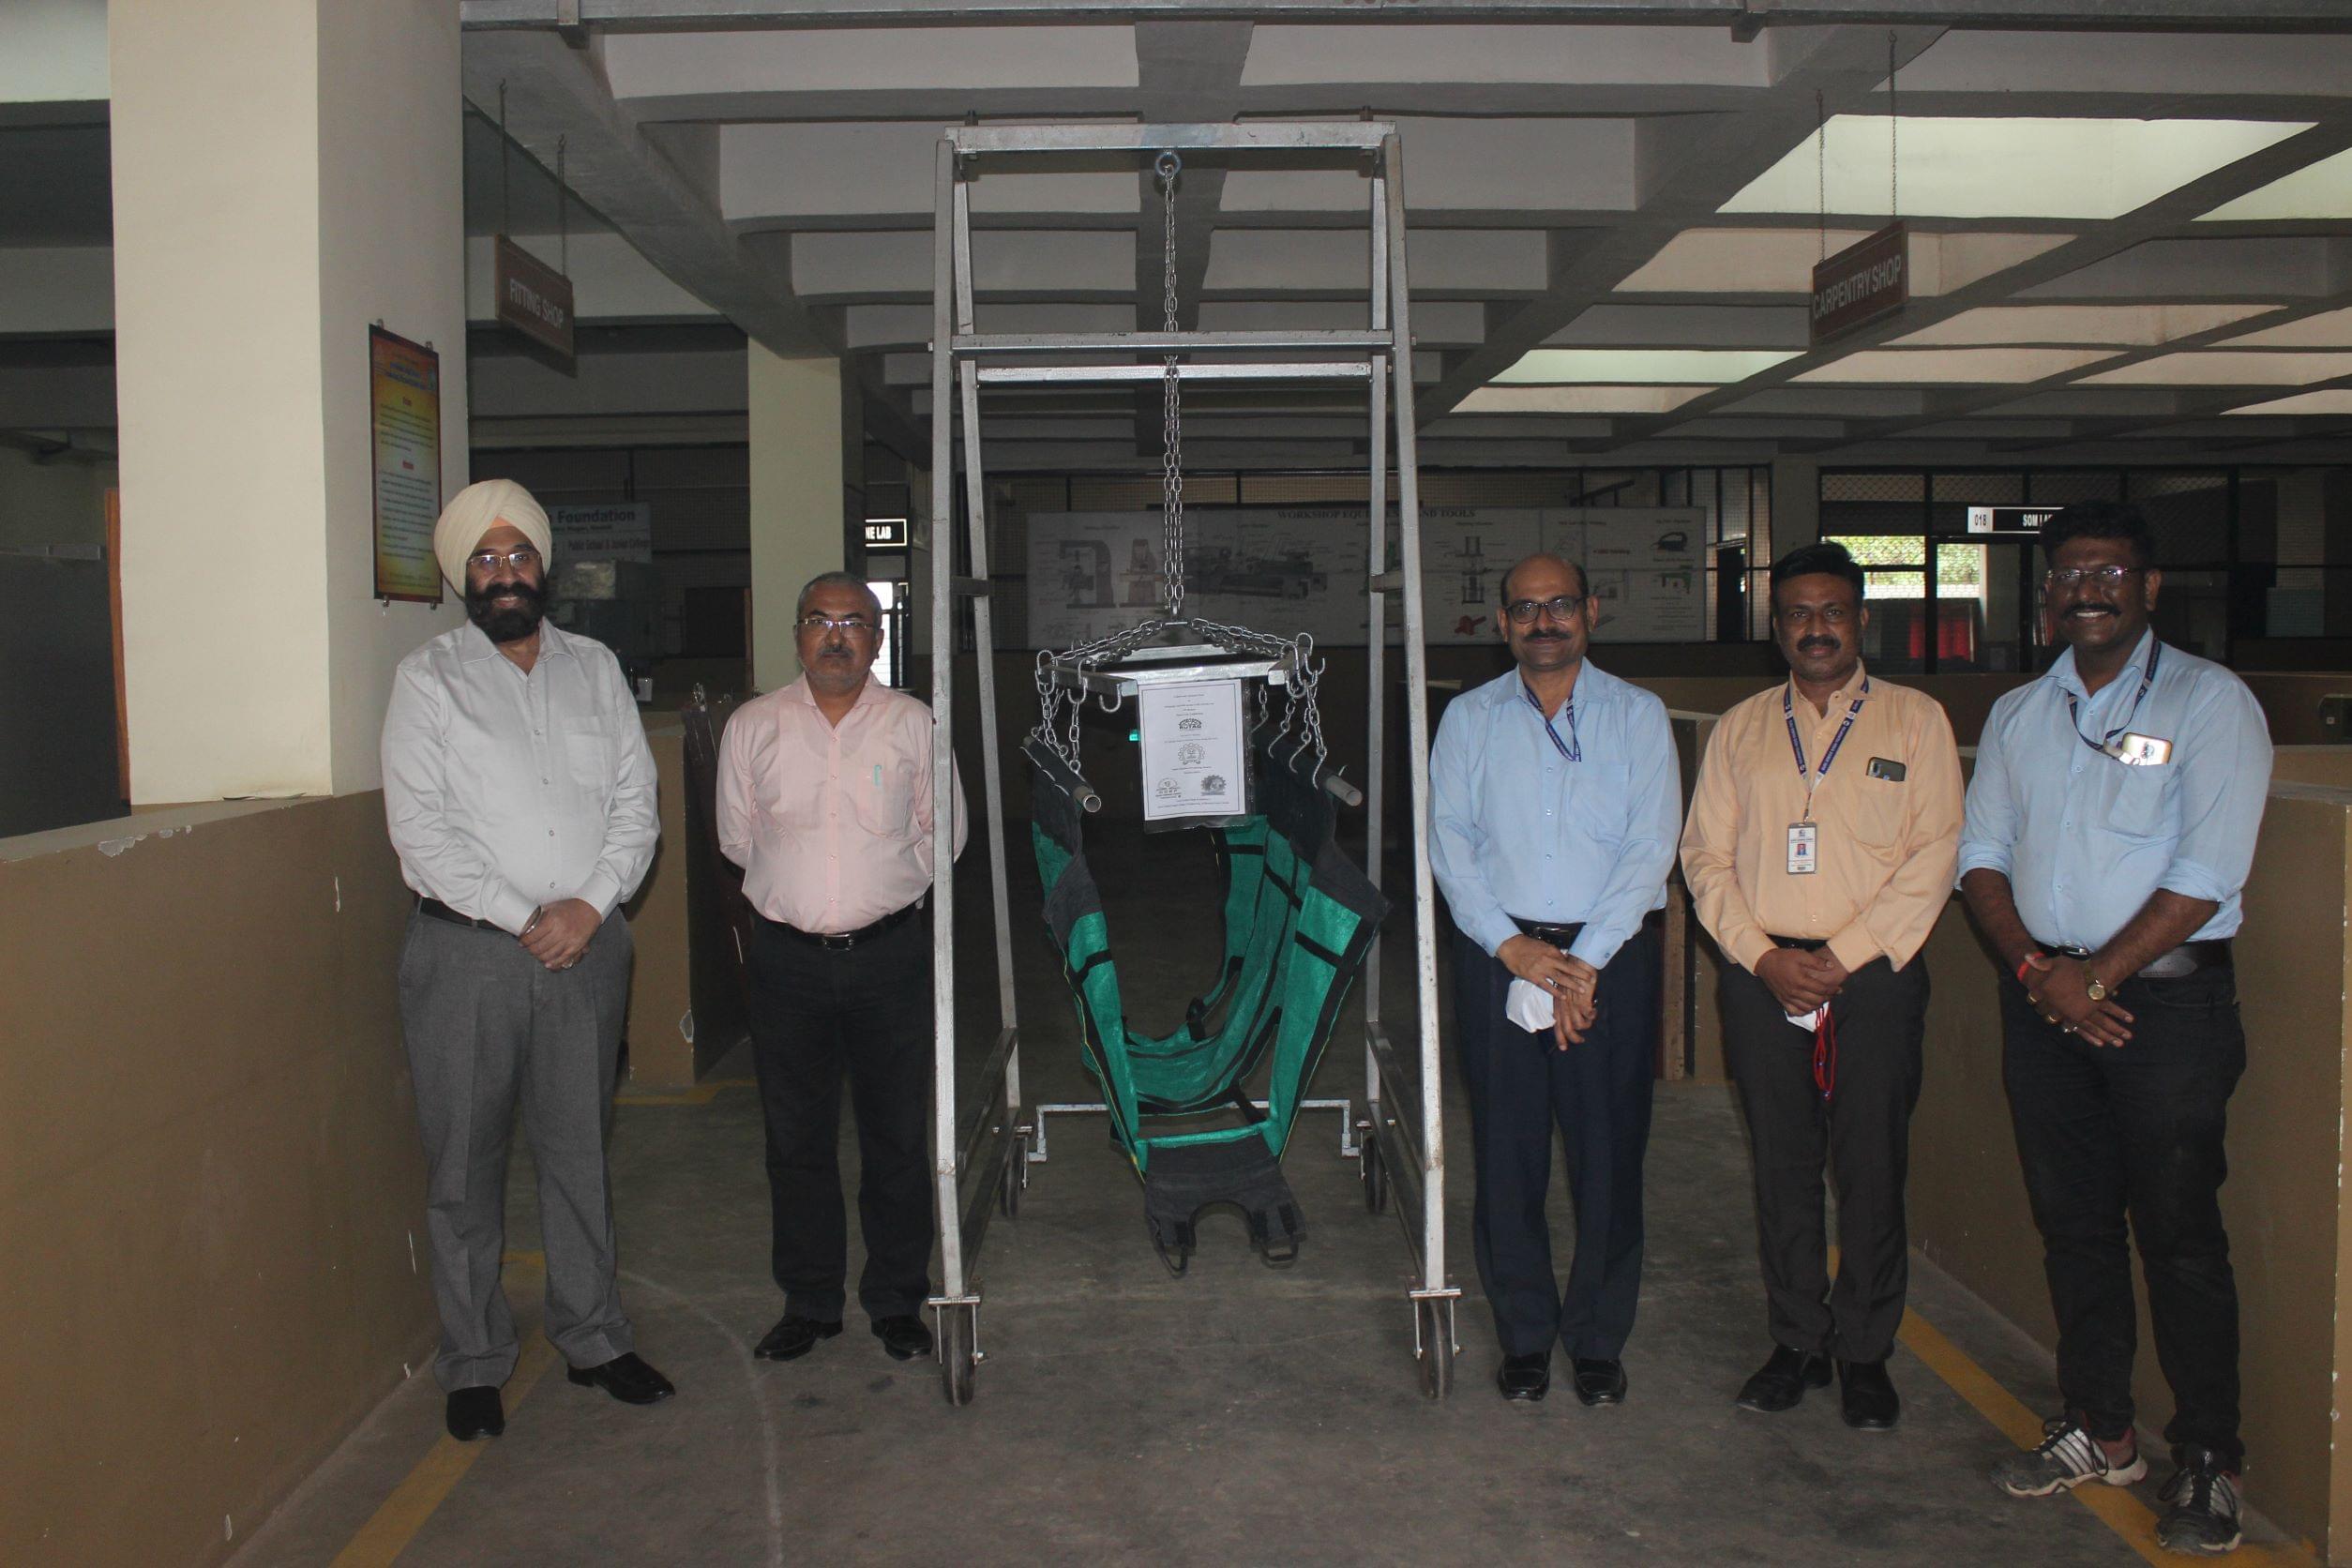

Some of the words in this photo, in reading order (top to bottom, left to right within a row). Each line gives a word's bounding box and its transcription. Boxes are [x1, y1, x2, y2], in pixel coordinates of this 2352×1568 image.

[1813, 268, 1872, 319] CARPENTRY
[1872, 254, 1902, 293] SHOP
[509, 278, 541, 317] FITTING
[542, 298, 564, 330] SHOP
[557, 508, 636, 523] Foundation
[1277, 509, 1339, 519] WORKSHOP
[1437, 509, 1476, 518] TOOLS
[1975, 514, 1987, 526] 018
[2022, 514, 2039, 527] SOM
[876, 525, 892, 540] LAB
